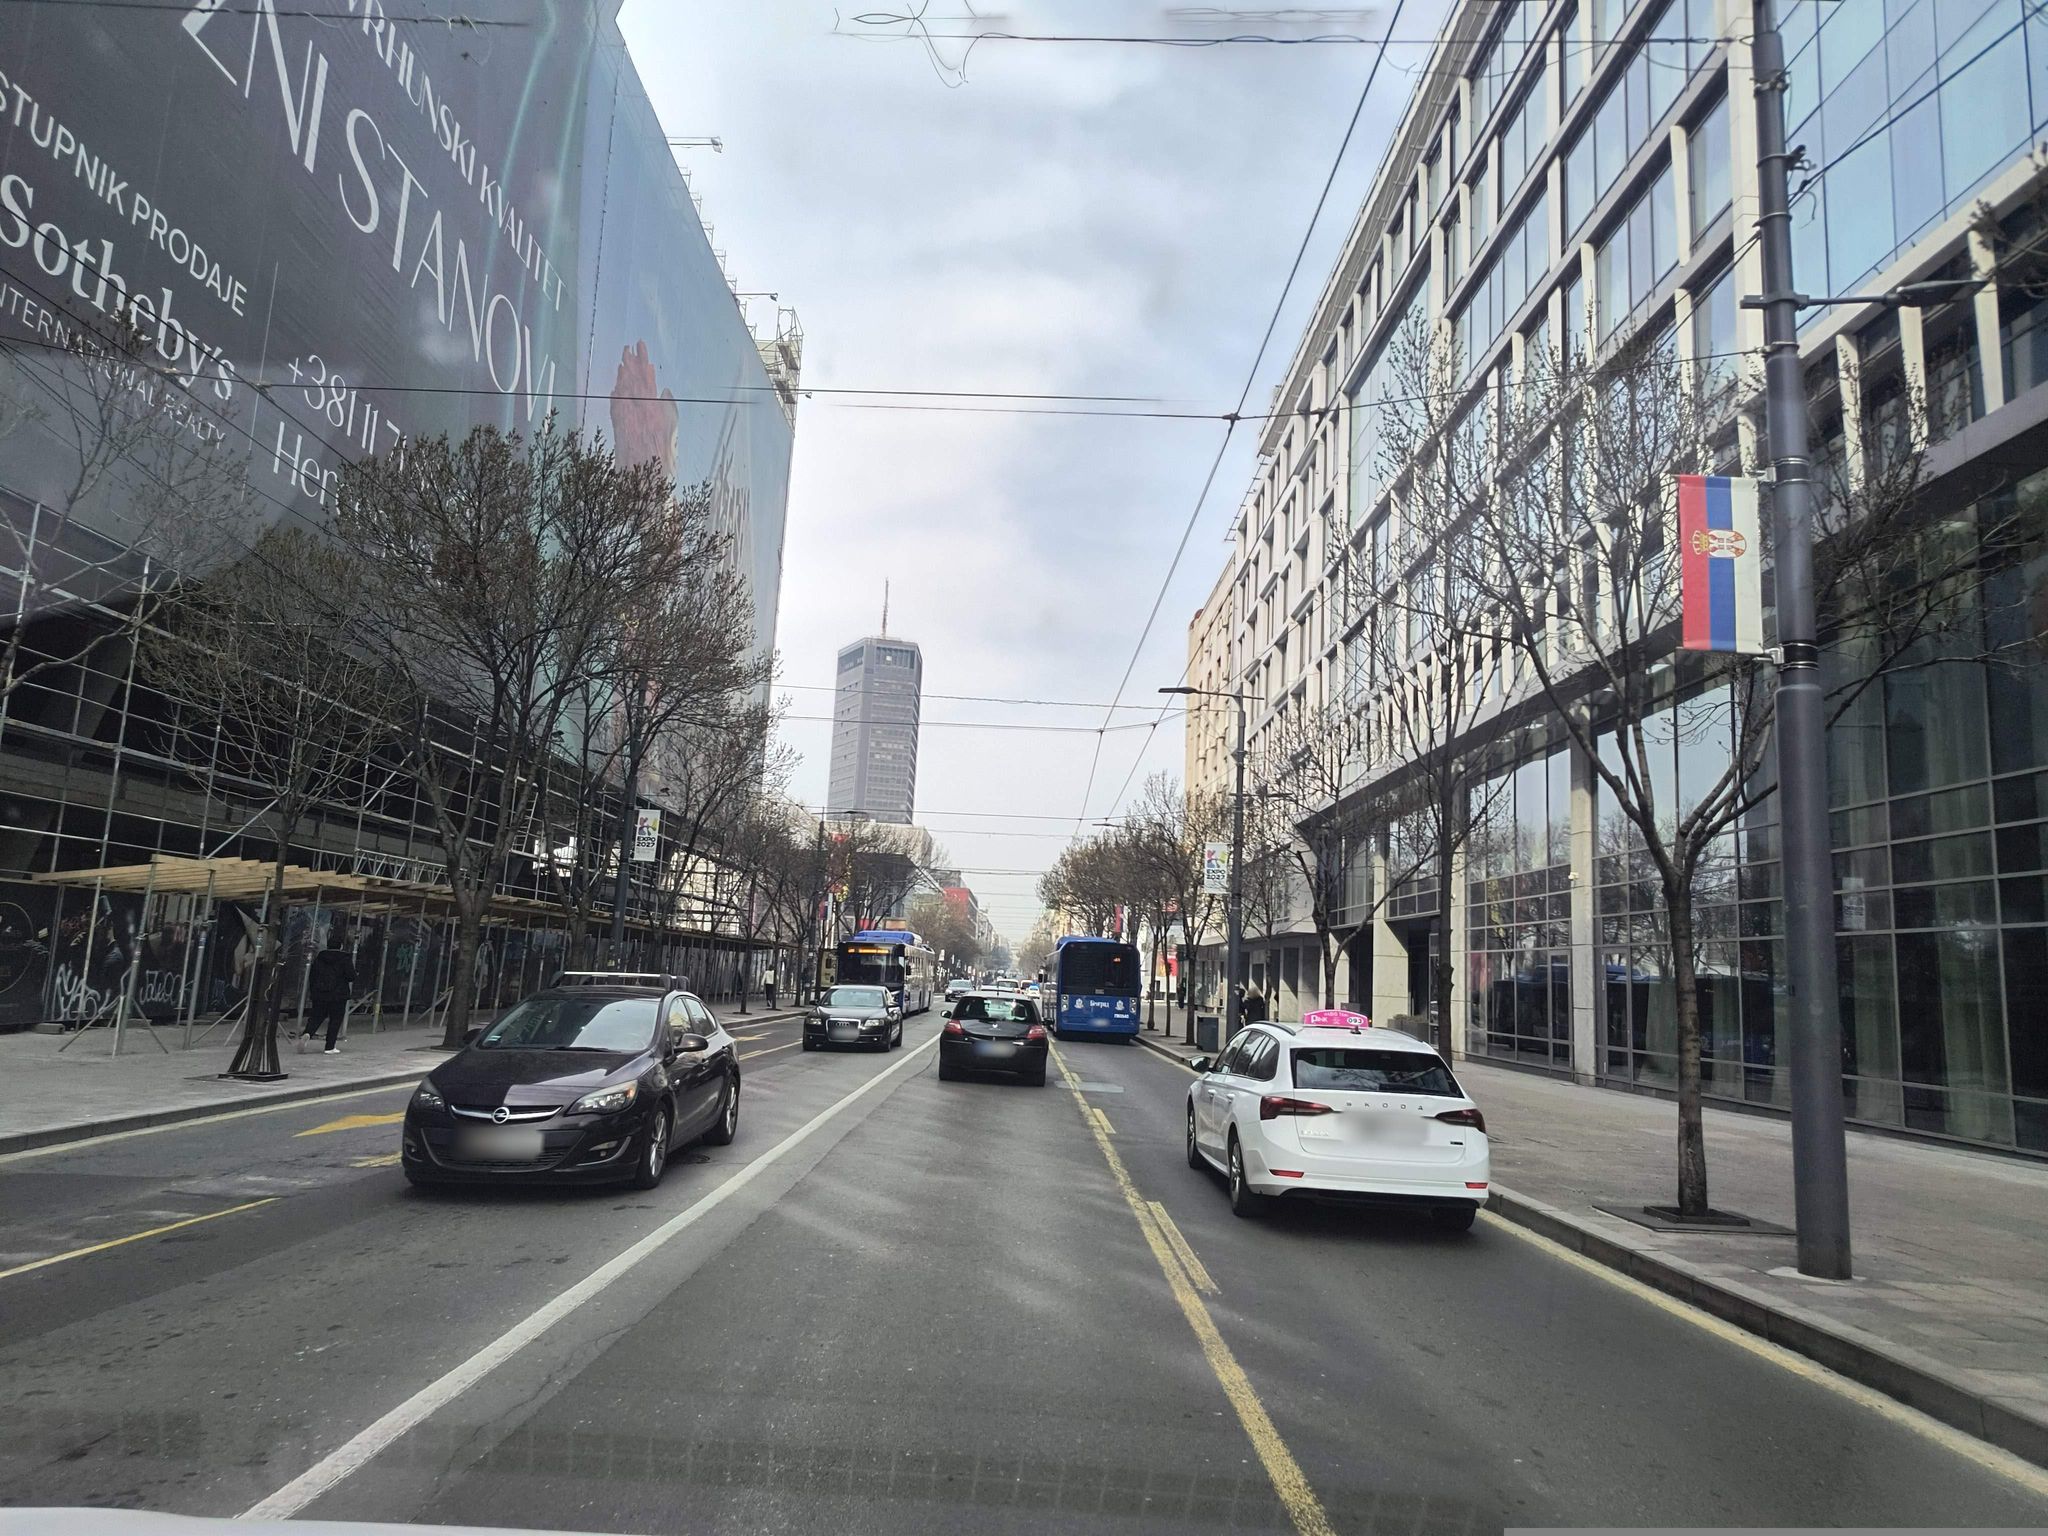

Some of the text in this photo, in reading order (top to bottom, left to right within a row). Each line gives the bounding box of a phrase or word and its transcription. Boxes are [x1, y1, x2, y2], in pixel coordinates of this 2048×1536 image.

[132, 193, 248, 317] PRODAJE
[349, 0, 566, 311] RHUNSKI KVALITET
[0, 174, 235, 401] Sotheby's
[338, 108, 556, 433] STANOVI
[288, 355, 357, 437] +381
